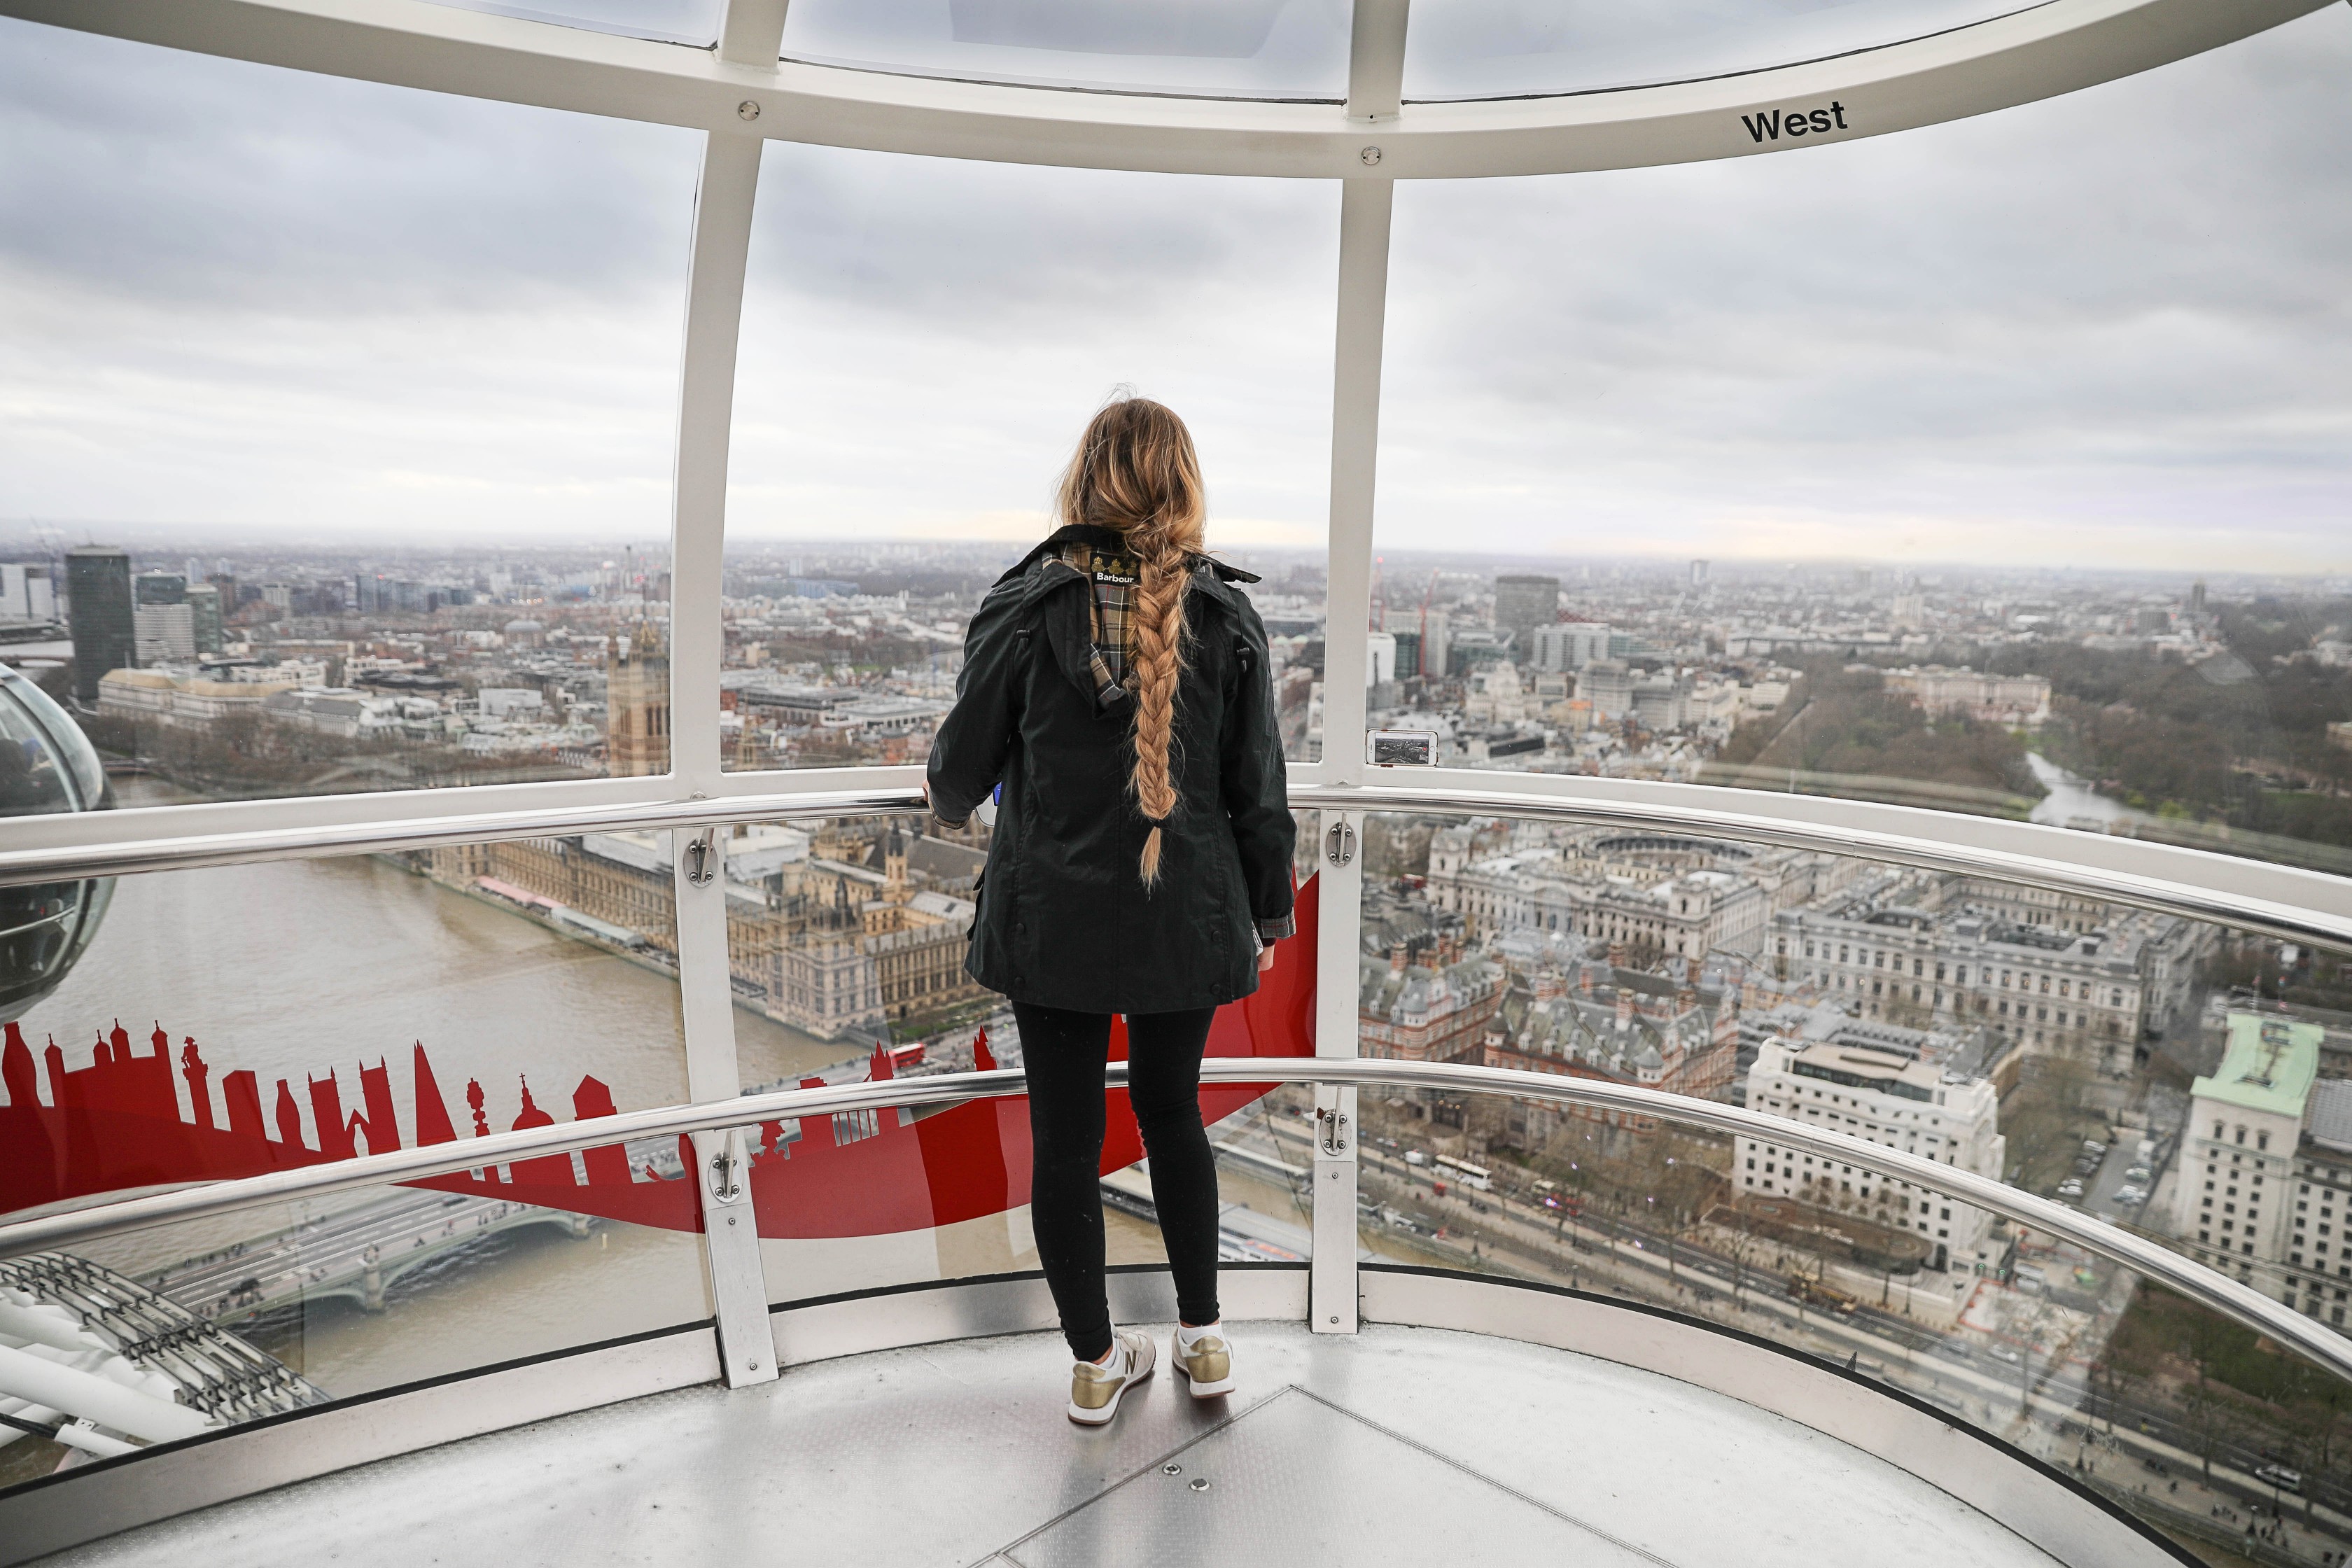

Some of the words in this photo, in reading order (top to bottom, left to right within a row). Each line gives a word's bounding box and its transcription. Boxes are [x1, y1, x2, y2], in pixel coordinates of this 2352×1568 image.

[1741, 101, 1848, 143] West
[1096, 572, 1134, 583] Barbour
[1125, 1350, 1137, 1374] N
